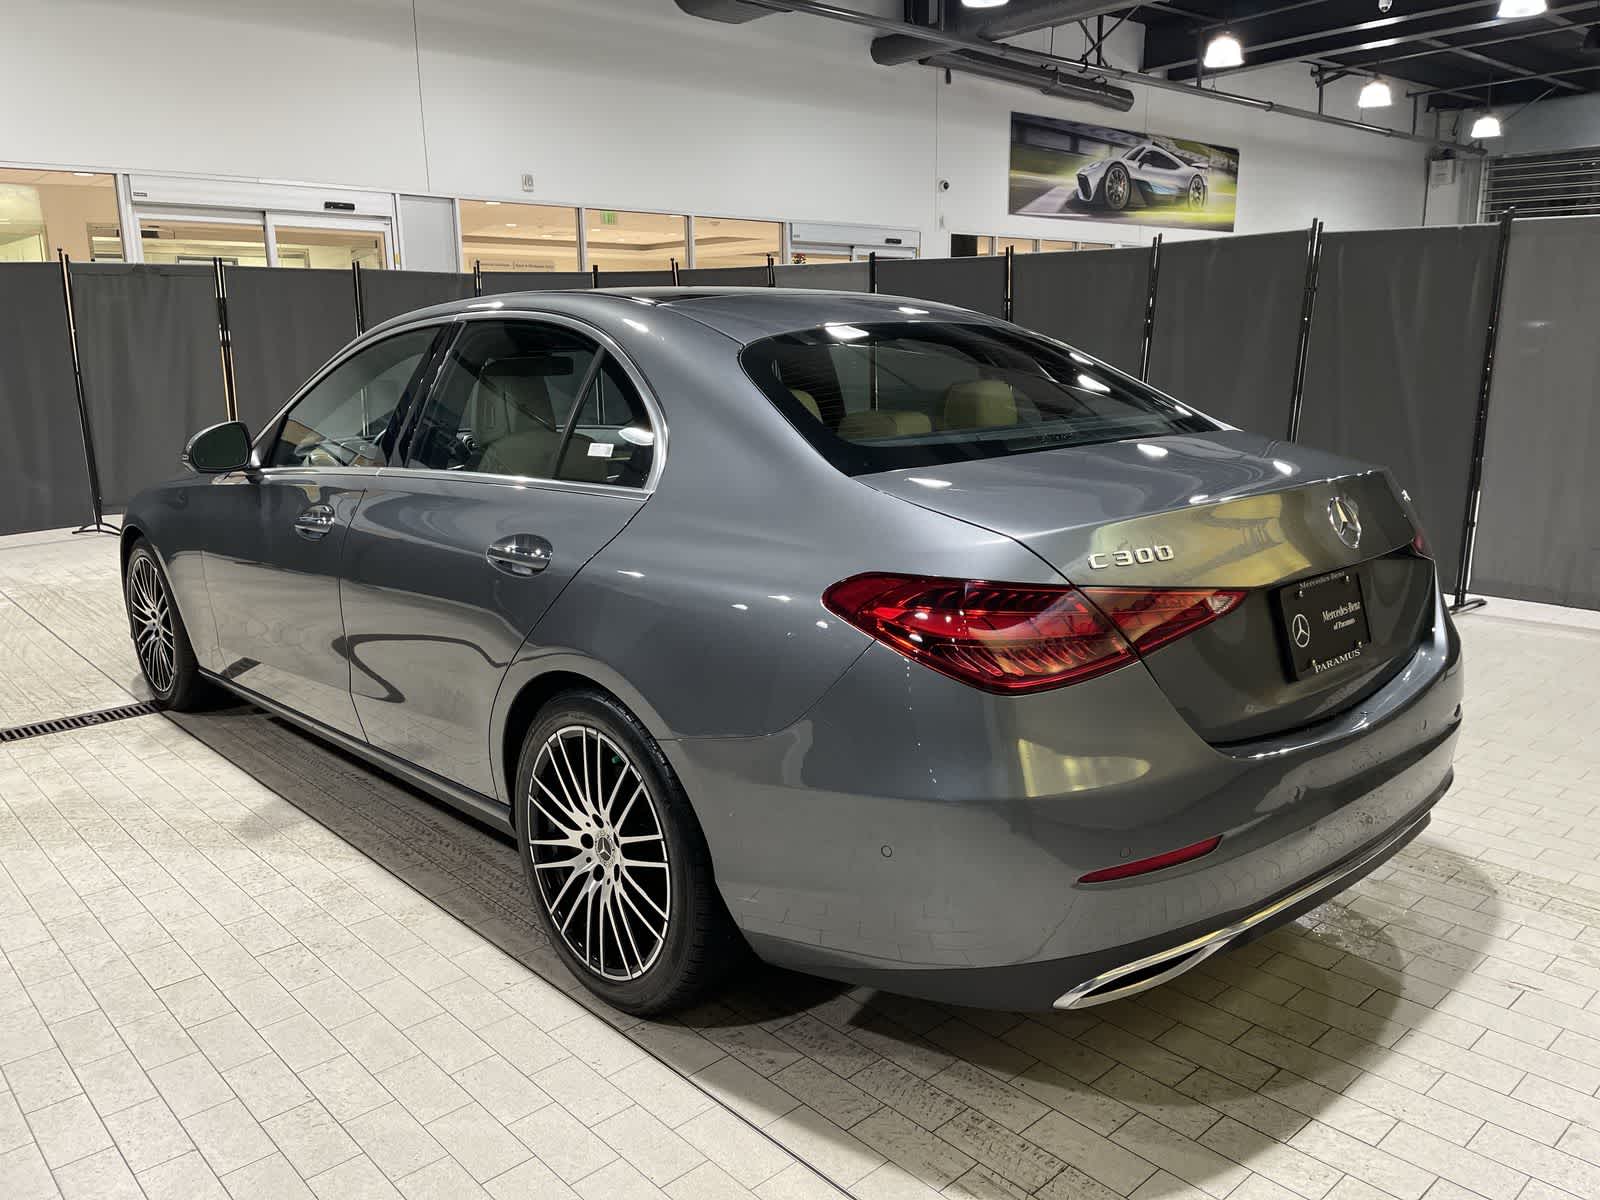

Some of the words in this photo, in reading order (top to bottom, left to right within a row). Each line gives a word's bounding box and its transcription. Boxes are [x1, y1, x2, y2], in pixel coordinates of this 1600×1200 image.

[1088, 553, 1109, 569] C
[1113, 545, 1175, 567] 300
[1322, 601, 1361, 622] Mercedes-Benz
[1315, 648, 1361, 673] PARAMUS
